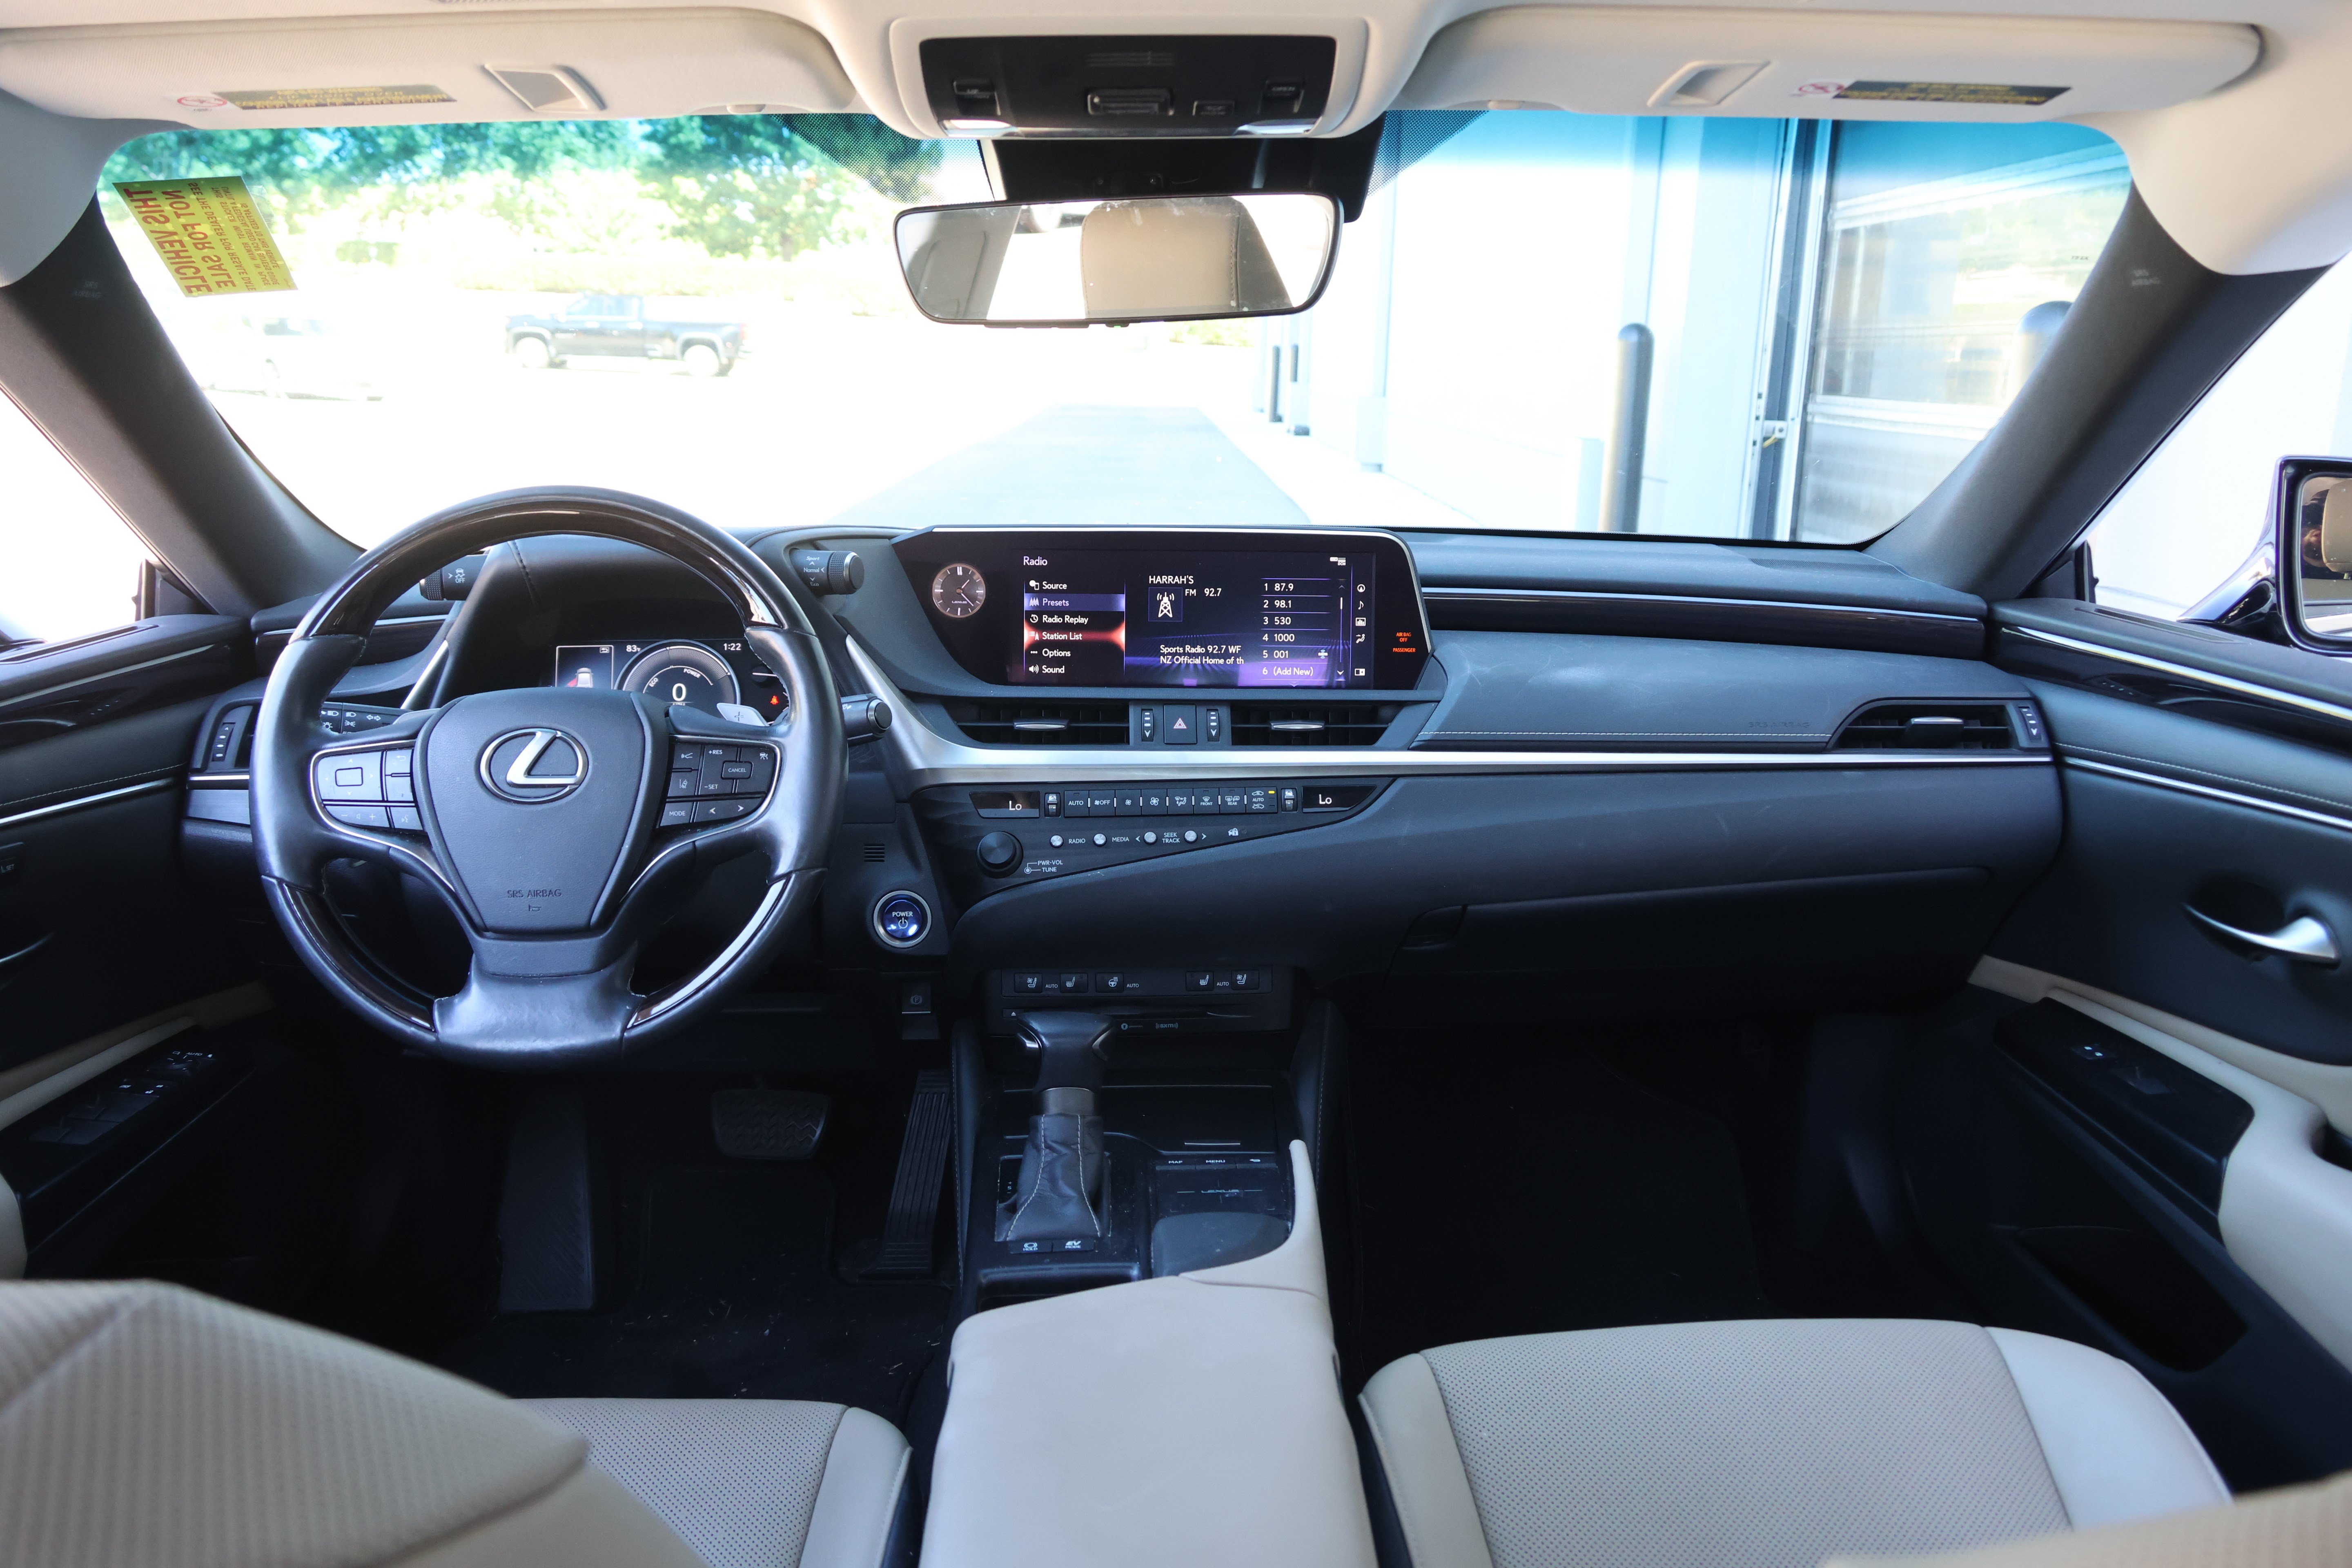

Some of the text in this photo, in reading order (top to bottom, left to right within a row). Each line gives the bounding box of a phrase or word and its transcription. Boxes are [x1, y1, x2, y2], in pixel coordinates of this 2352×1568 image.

[1024, 556, 1047, 565] Radio
[1149, 575, 1194, 584] HARRAH'S
[1274, 583, 1294, 591] 87.9
[1205, 588, 1221, 596] 92.7
[1065, 615, 1088, 624] Replay
[1042, 648, 1071, 658] Options
[1160, 645, 1183, 654] Sports
[1174, 656, 1200, 664] Official
[684, 668, 701, 678] POWER
[1273, 667, 1292, 675] (Add
[1294, 667, 1313, 676] New)
[649, 677, 659, 687] ECO
[673, 683, 686, 701] 0
[1319, 794, 1332, 804] Lo
[1009, 801, 1022, 811] Lo
[527, 889, 562, 898] AIRBAG
